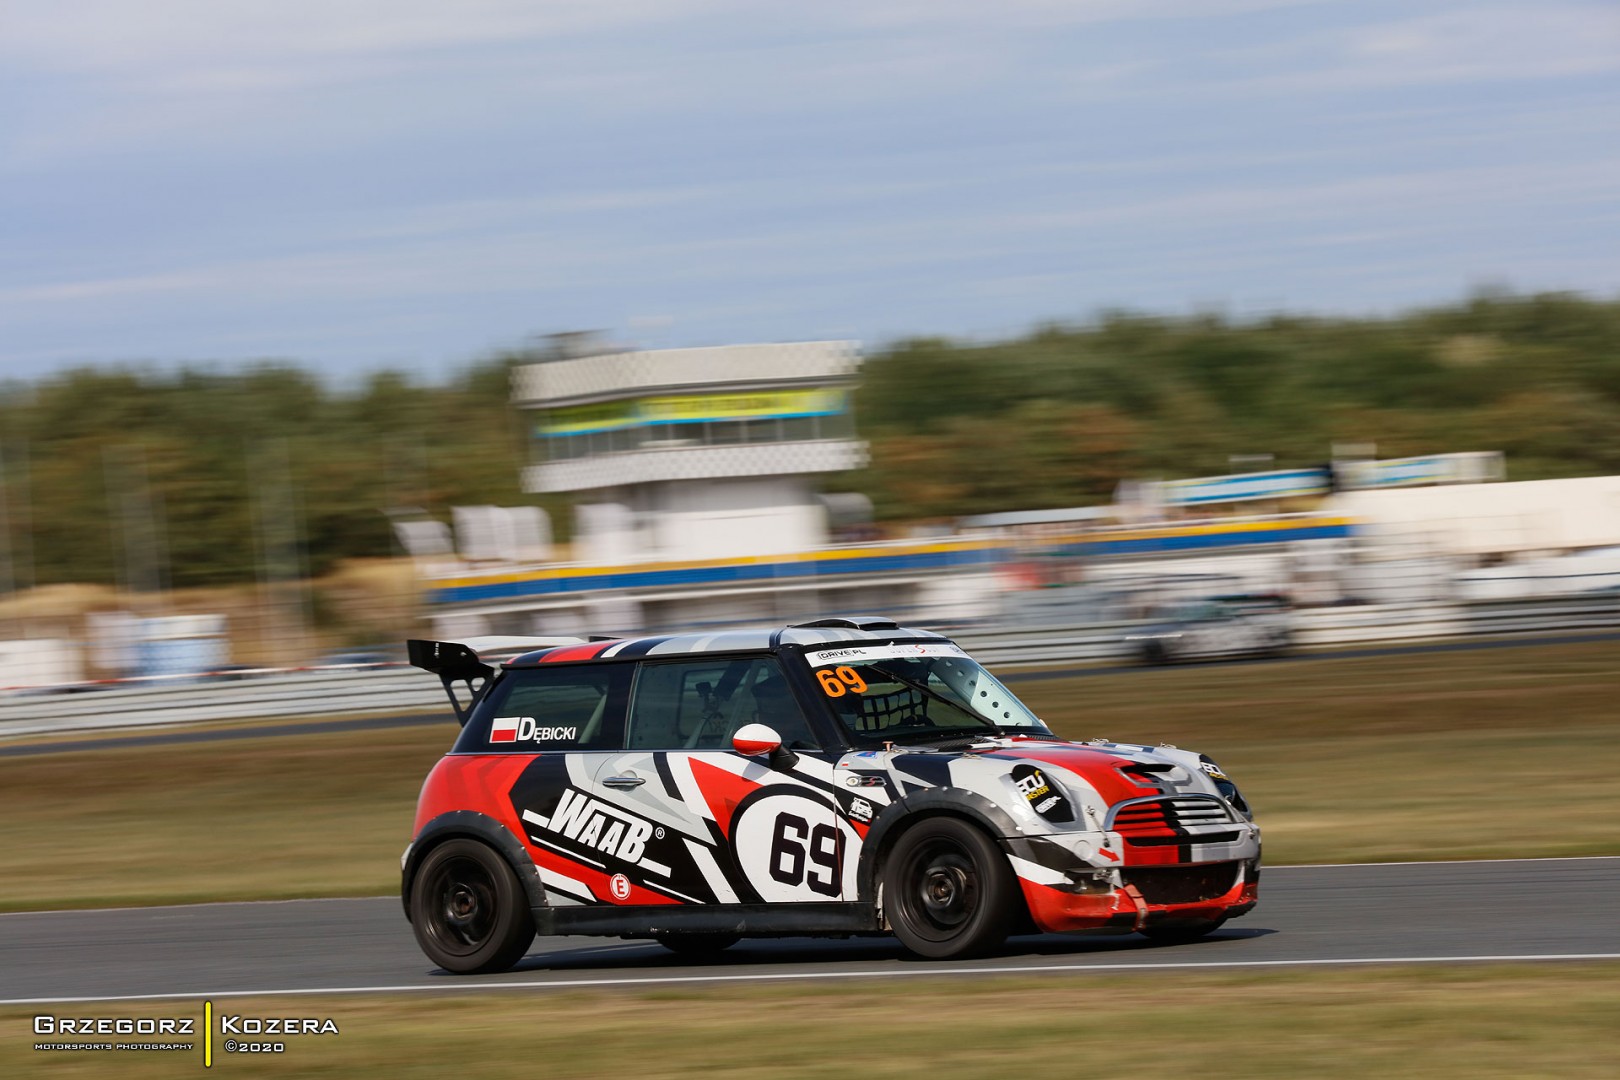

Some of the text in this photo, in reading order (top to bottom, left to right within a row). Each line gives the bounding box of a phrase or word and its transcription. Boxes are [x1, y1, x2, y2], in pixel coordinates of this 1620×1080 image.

[815, 665, 868, 698] 69
[517, 717, 577, 744] DĘBICKI
[769, 811, 847, 898] 69
